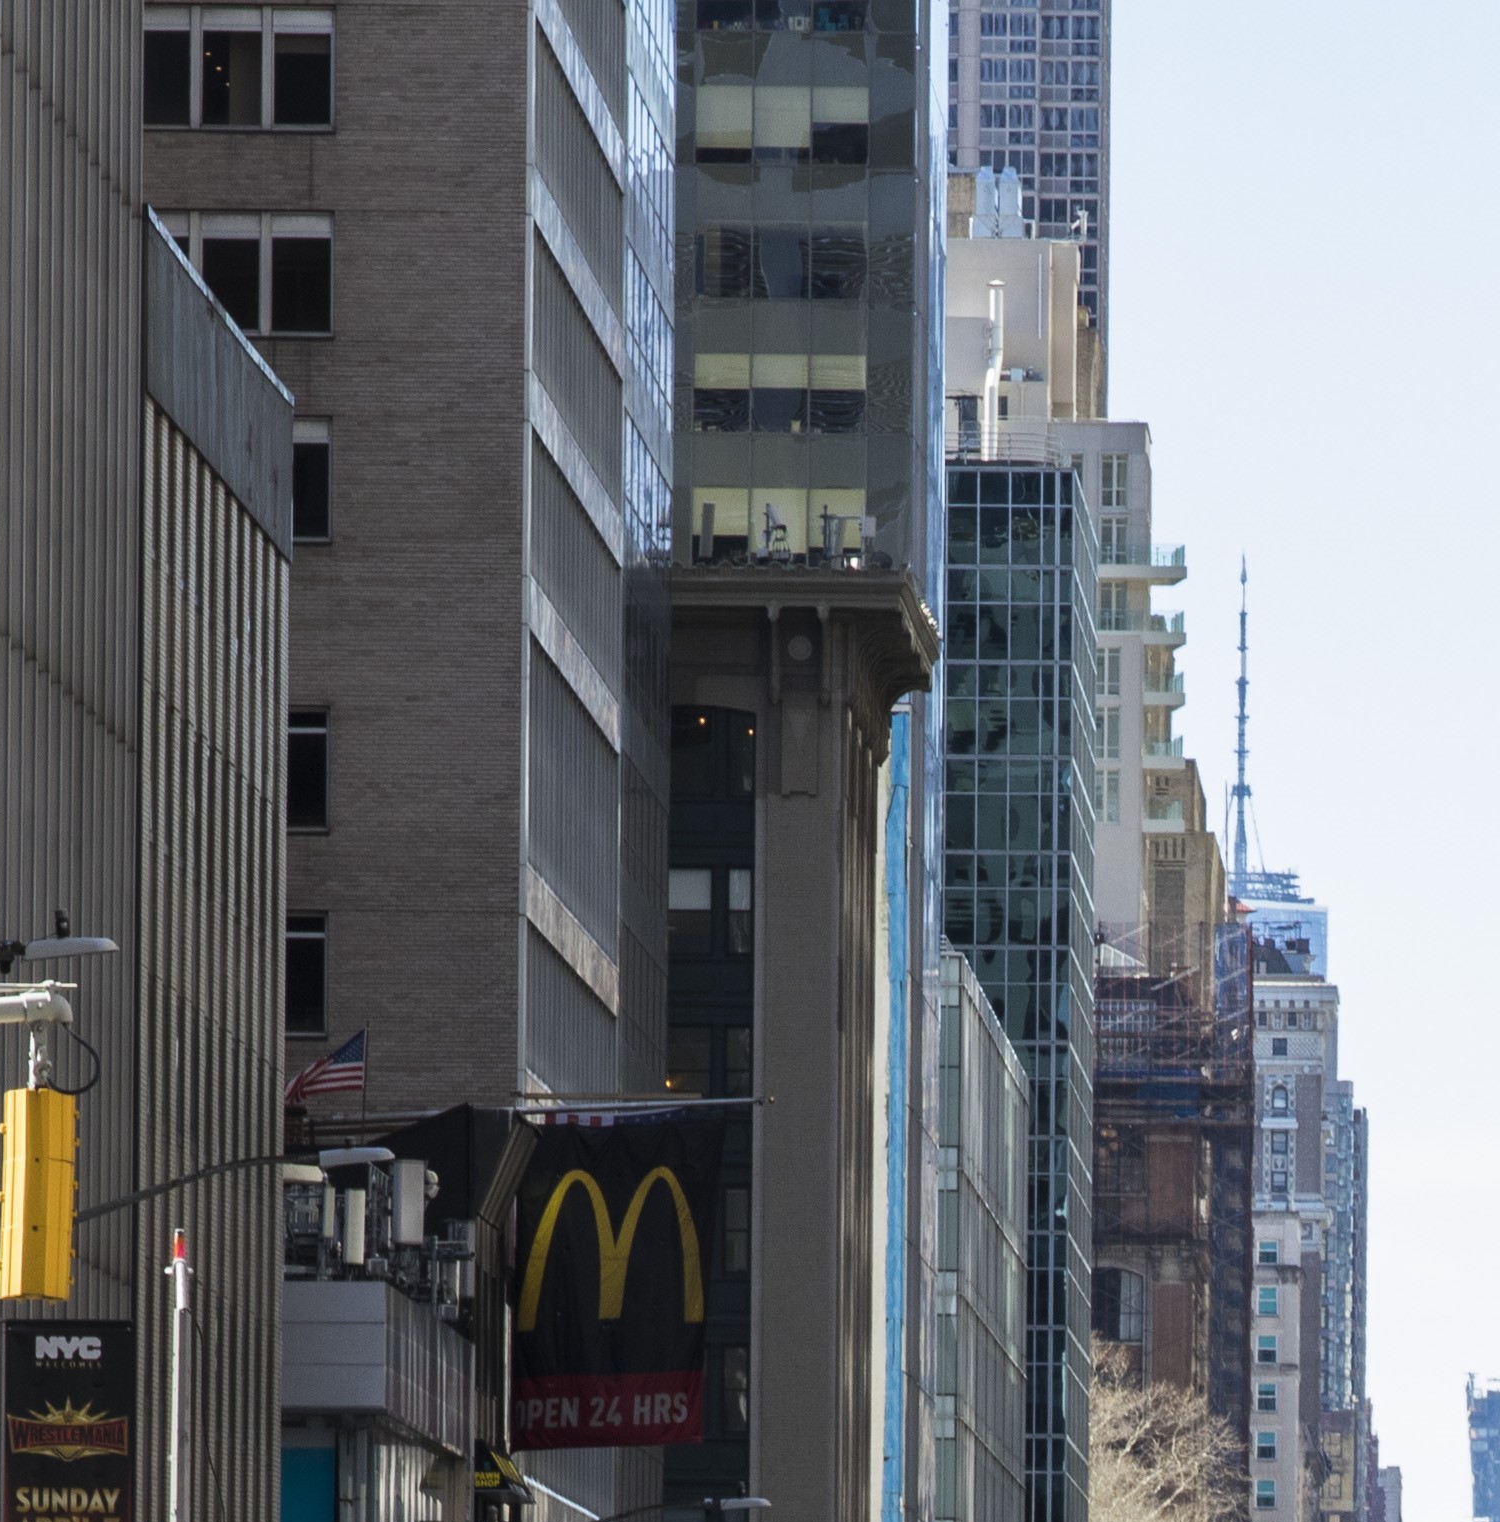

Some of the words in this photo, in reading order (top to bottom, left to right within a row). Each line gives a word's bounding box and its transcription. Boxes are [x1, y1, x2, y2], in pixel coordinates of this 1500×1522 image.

[35, 1336, 101, 1359] NYC
[589, 1396, 622, 1427] 24
[633, 1393, 688, 1425] HRS
[475, 1471, 500, 1480] PAWN
[475, 1480, 500, 1488] SHOP
[16, 1487, 120, 1513] SUNDAY
